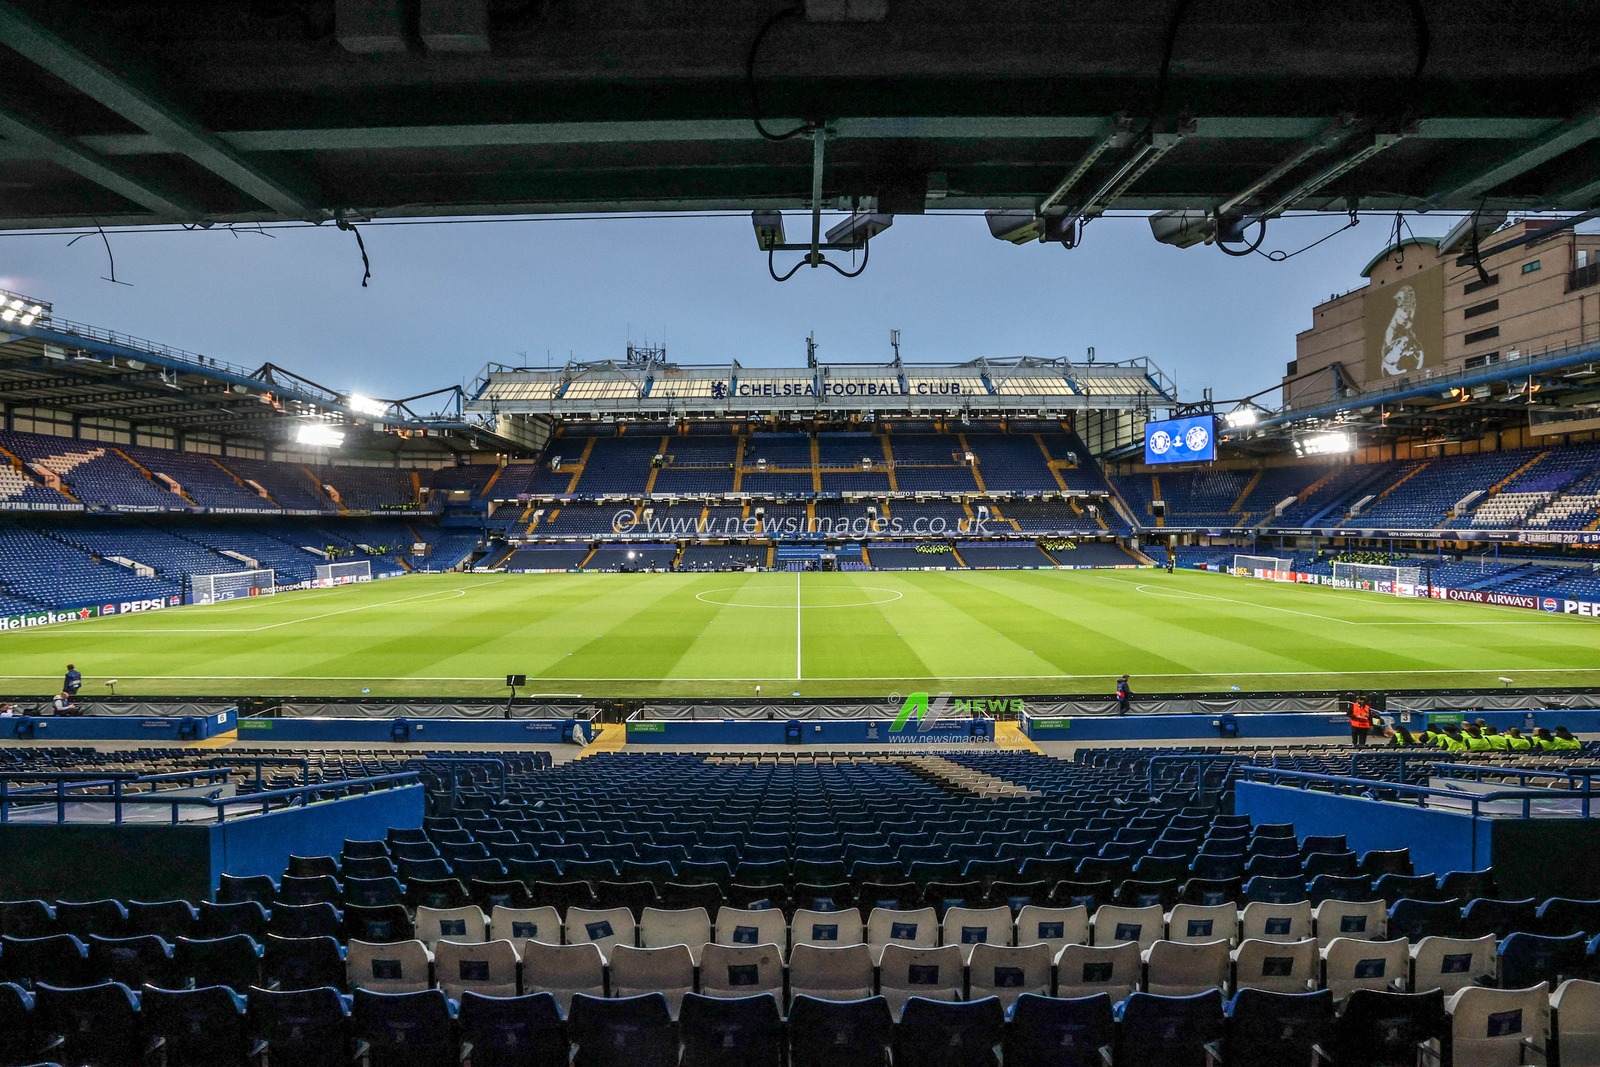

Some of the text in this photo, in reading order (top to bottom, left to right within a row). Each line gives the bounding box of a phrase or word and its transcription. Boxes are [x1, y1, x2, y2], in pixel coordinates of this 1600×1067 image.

[739, 383, 960, 396] CHELSEA FOOTBALL CLUB
[32, 503, 59, 511] LEADER,
[60, 503, 84, 511] LEGEND
[1414, 586, 1441, 598] FedEx
[1449, 589, 1534, 607] QATAR AIRWAYS
[120, 597, 166, 613] PEPSI
[0, 611, 77, 631] Heineken
